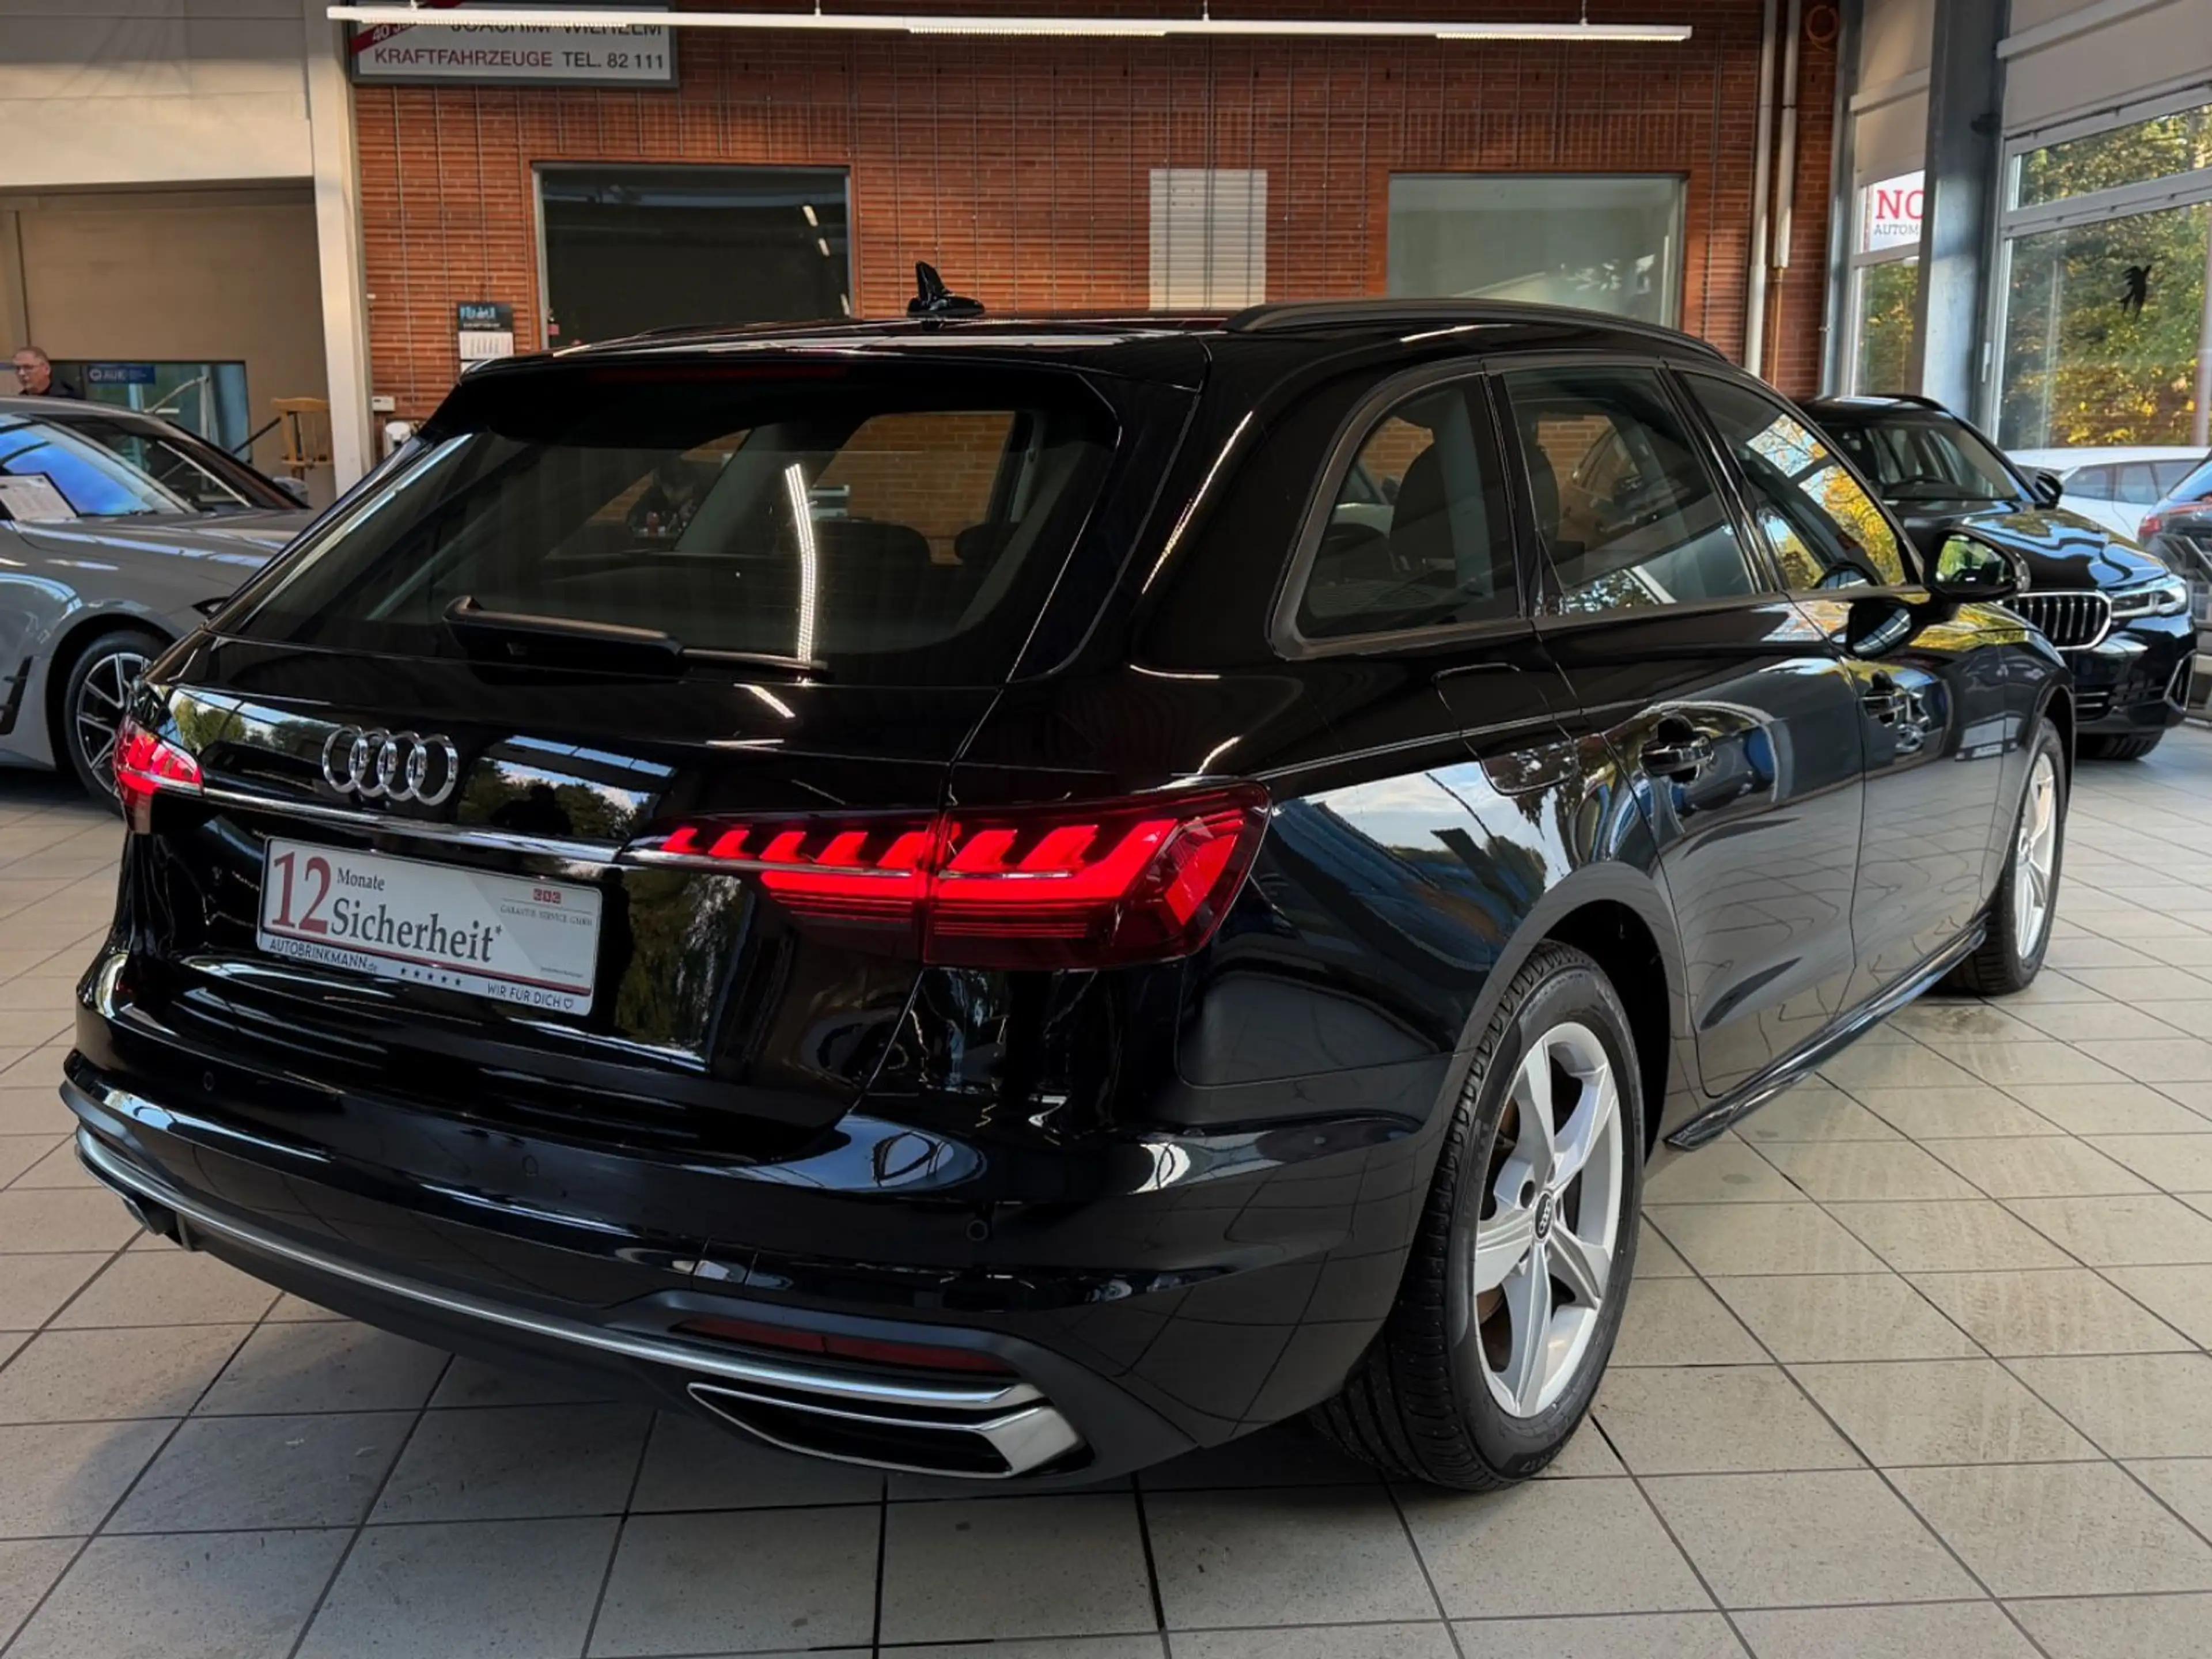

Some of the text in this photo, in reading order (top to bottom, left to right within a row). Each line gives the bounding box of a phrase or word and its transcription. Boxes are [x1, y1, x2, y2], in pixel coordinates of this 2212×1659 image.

[375, 48, 662, 70] KRAFTFAHRZEUGE TEL. 82 111
[272, 851, 385, 934] 12 Monate
[487, 981, 506, 997] WIR
[533, 991, 560, 1007] DICH
